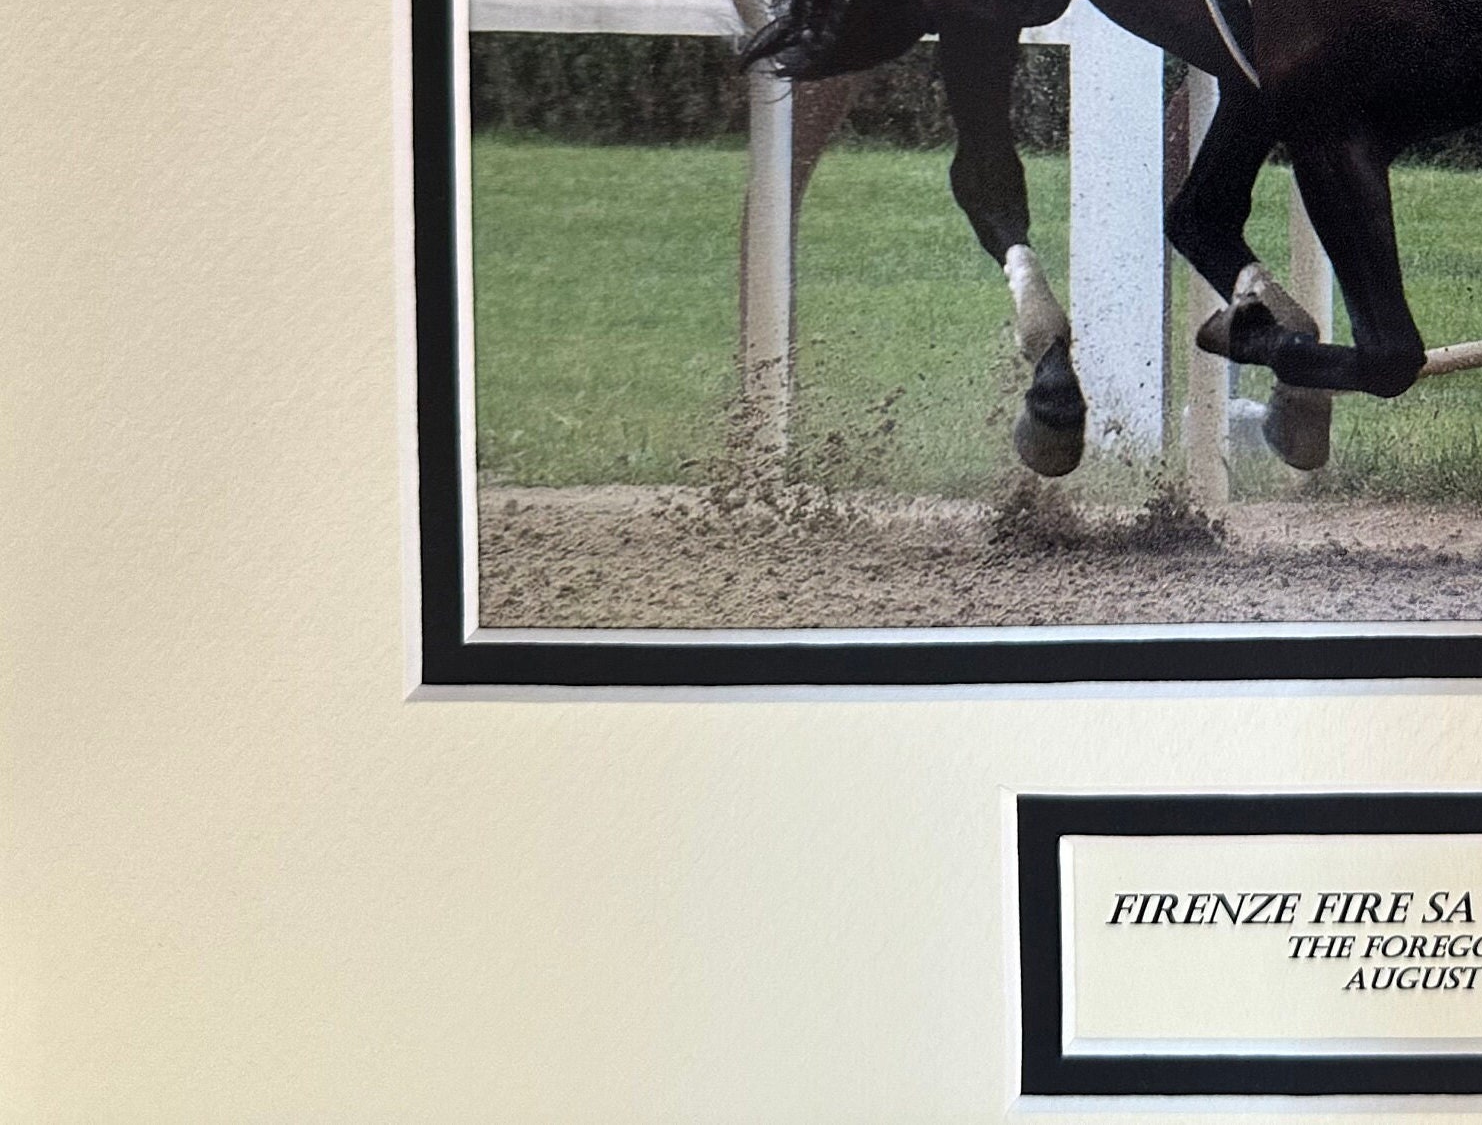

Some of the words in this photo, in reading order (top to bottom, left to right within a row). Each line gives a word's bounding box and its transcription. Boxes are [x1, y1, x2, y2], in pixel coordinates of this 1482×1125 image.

[1106, 893, 1301, 925] FIRENZE
[1308, 892, 1414, 924] FIRE
[1289, 935, 1356, 959] THE
